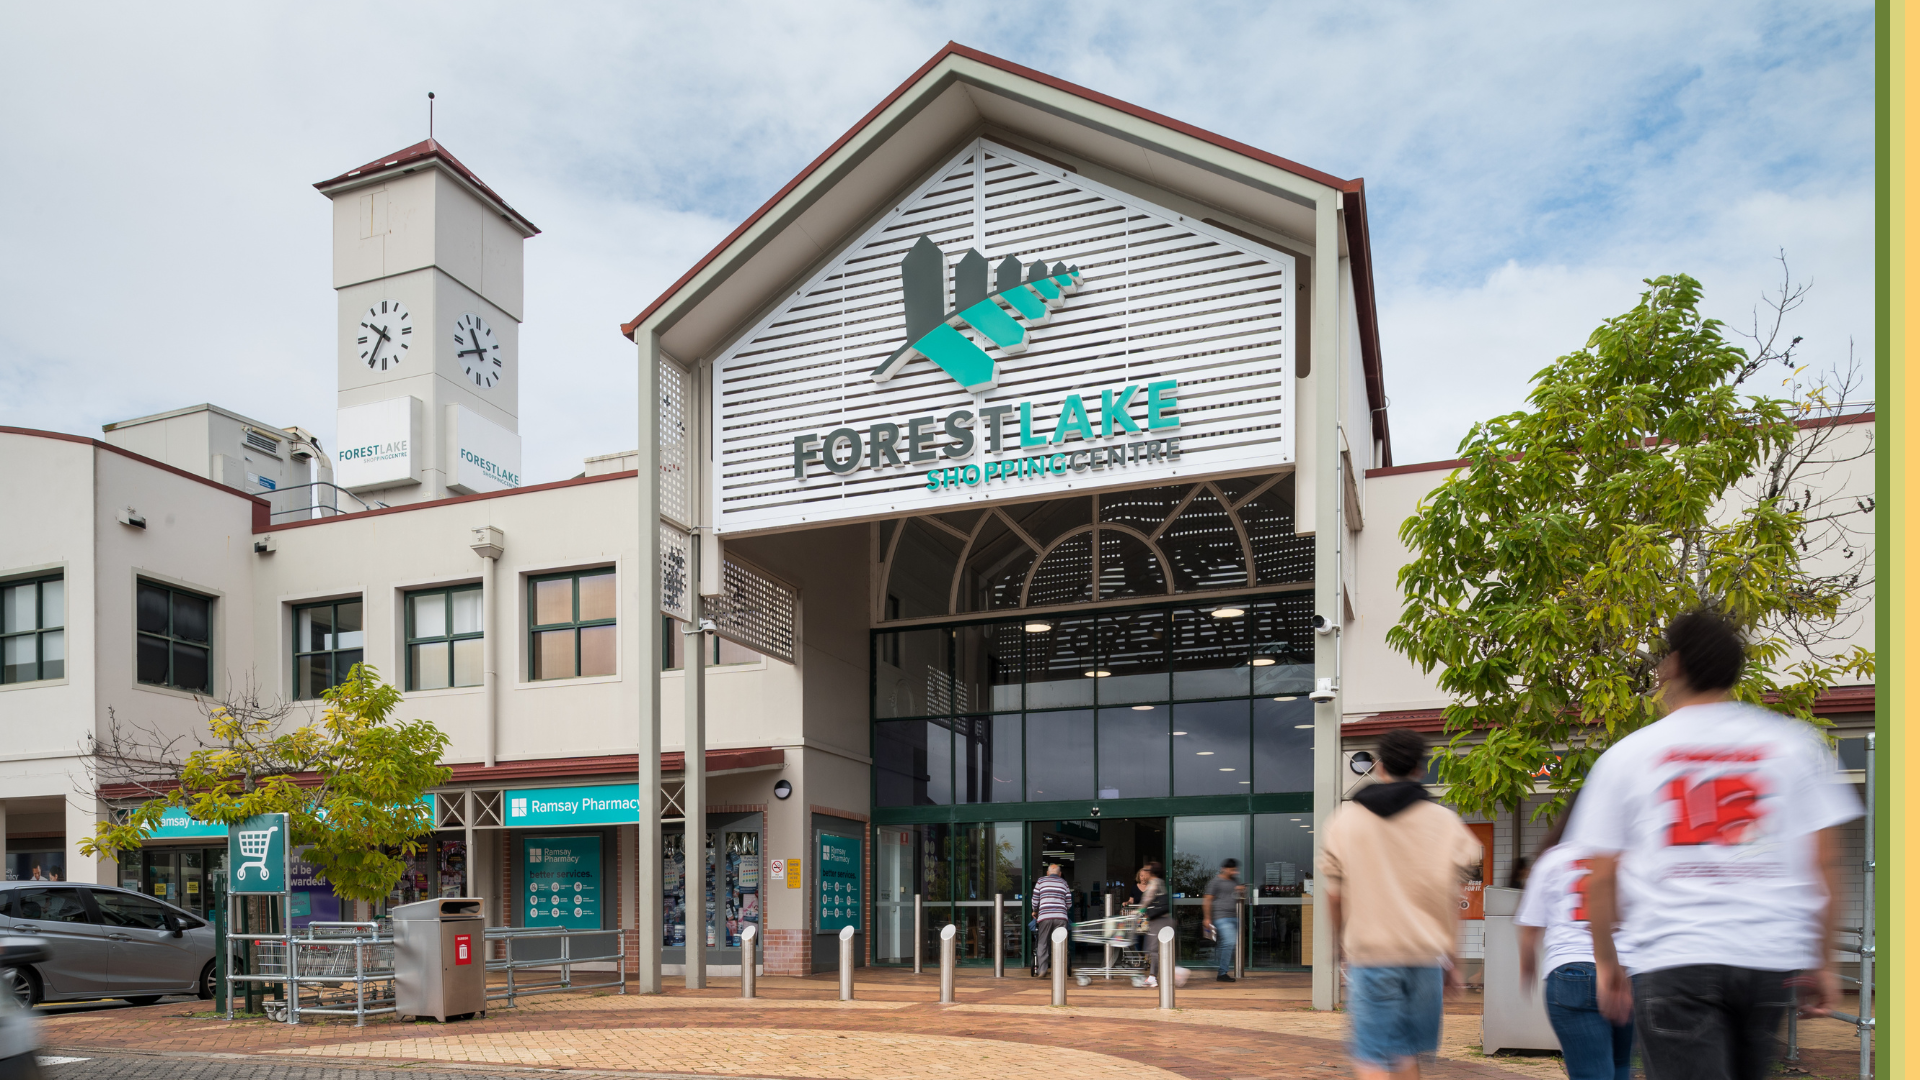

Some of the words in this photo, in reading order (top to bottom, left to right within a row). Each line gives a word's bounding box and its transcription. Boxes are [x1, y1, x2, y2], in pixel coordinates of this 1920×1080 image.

[531, 799, 579, 815] Ramsay
[544, 847, 572, 857] Ramsay
[544, 855, 580, 864] Pharmacy
[300, 865, 312, 875] be
[529, 870, 555, 879] better
[556, 869, 593, 878] services.
[823, 868, 836, 877] better
[287, 876, 326, 886] warded!
